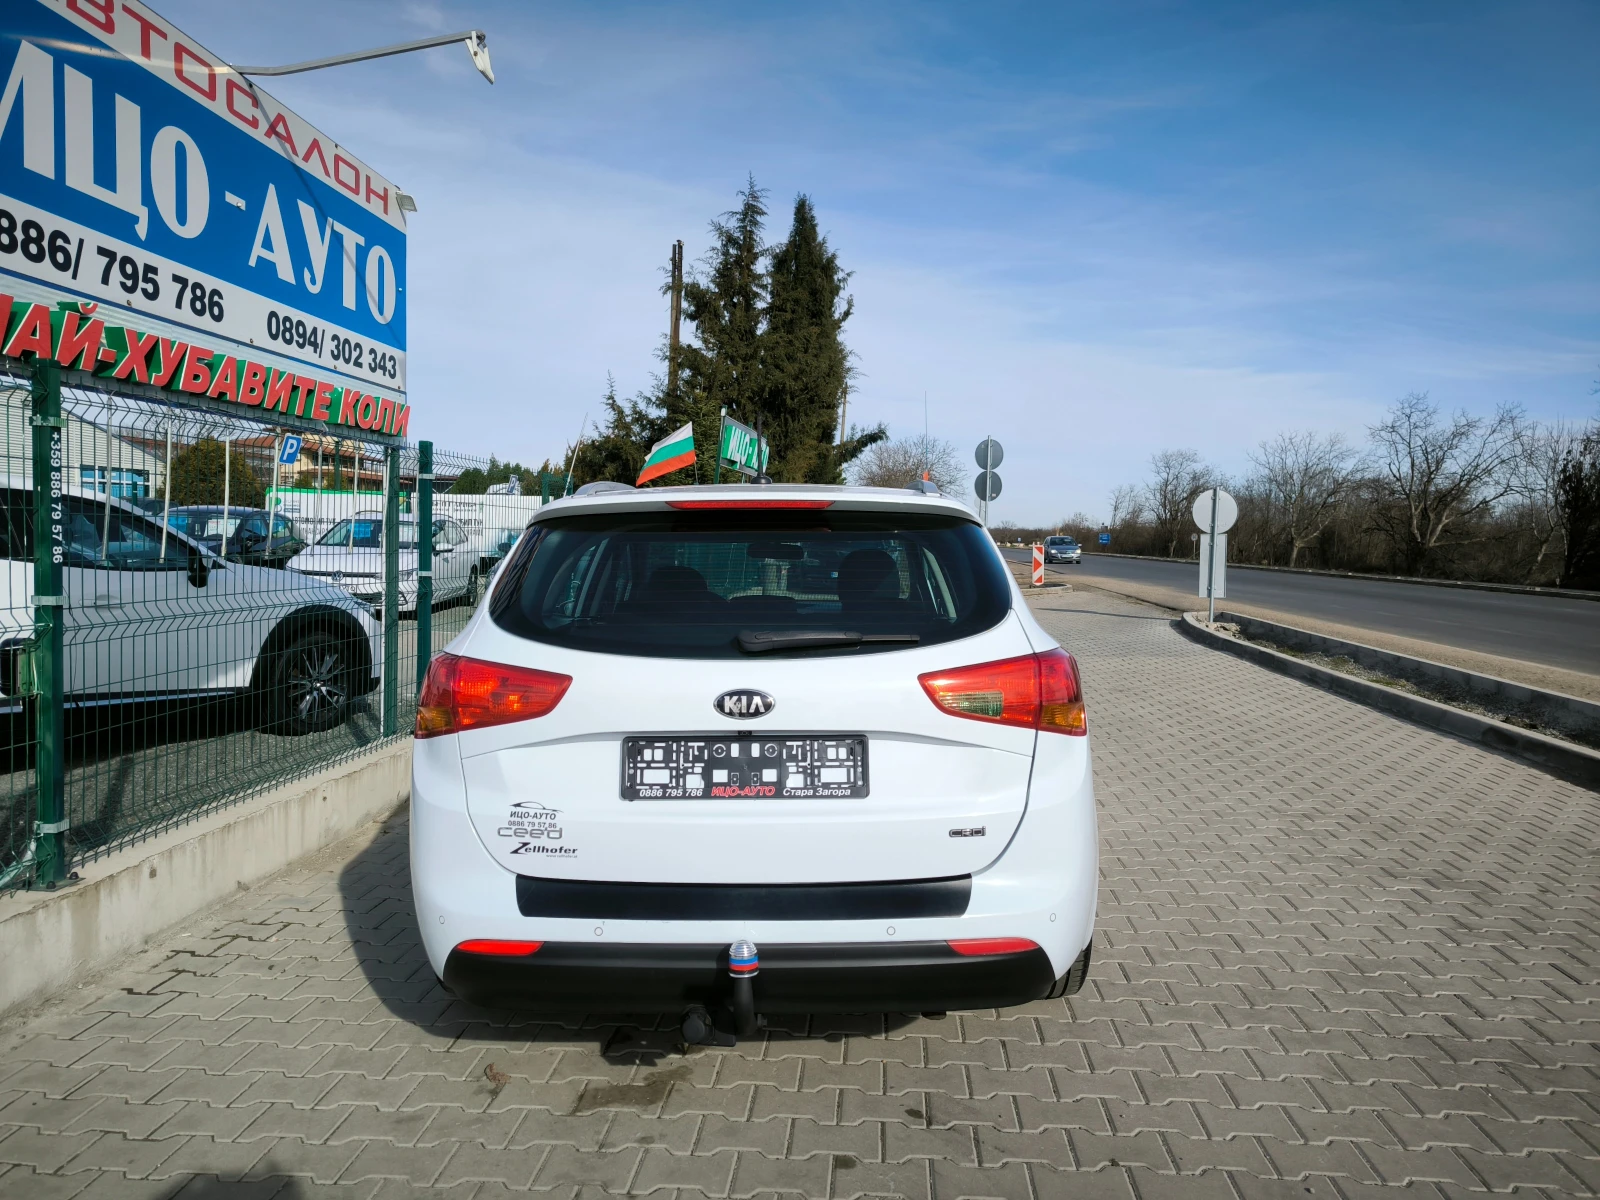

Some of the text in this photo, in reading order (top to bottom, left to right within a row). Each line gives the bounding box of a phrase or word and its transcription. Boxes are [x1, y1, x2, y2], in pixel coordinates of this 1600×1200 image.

[97, 245, 160, 301] 795
[172, 273, 224, 322] 786
[267, 310, 396, 379] 0894/ 302 343
[338, 388, 411, 437] КОЛИ
[283, 439, 298, 460] P
[51, 432, 63, 563] +359 886 79 57 86
[724, 695, 765, 713] KIA
[639, 788, 703, 797] 0886 795 786
[711, 786, 775, 798] ИЦО-АУТО
[783, 787, 851, 798] Стара Загора
[510, 811, 556, 821] ИЦО-АУТО
[510, 842, 578, 855] Zellhofer
